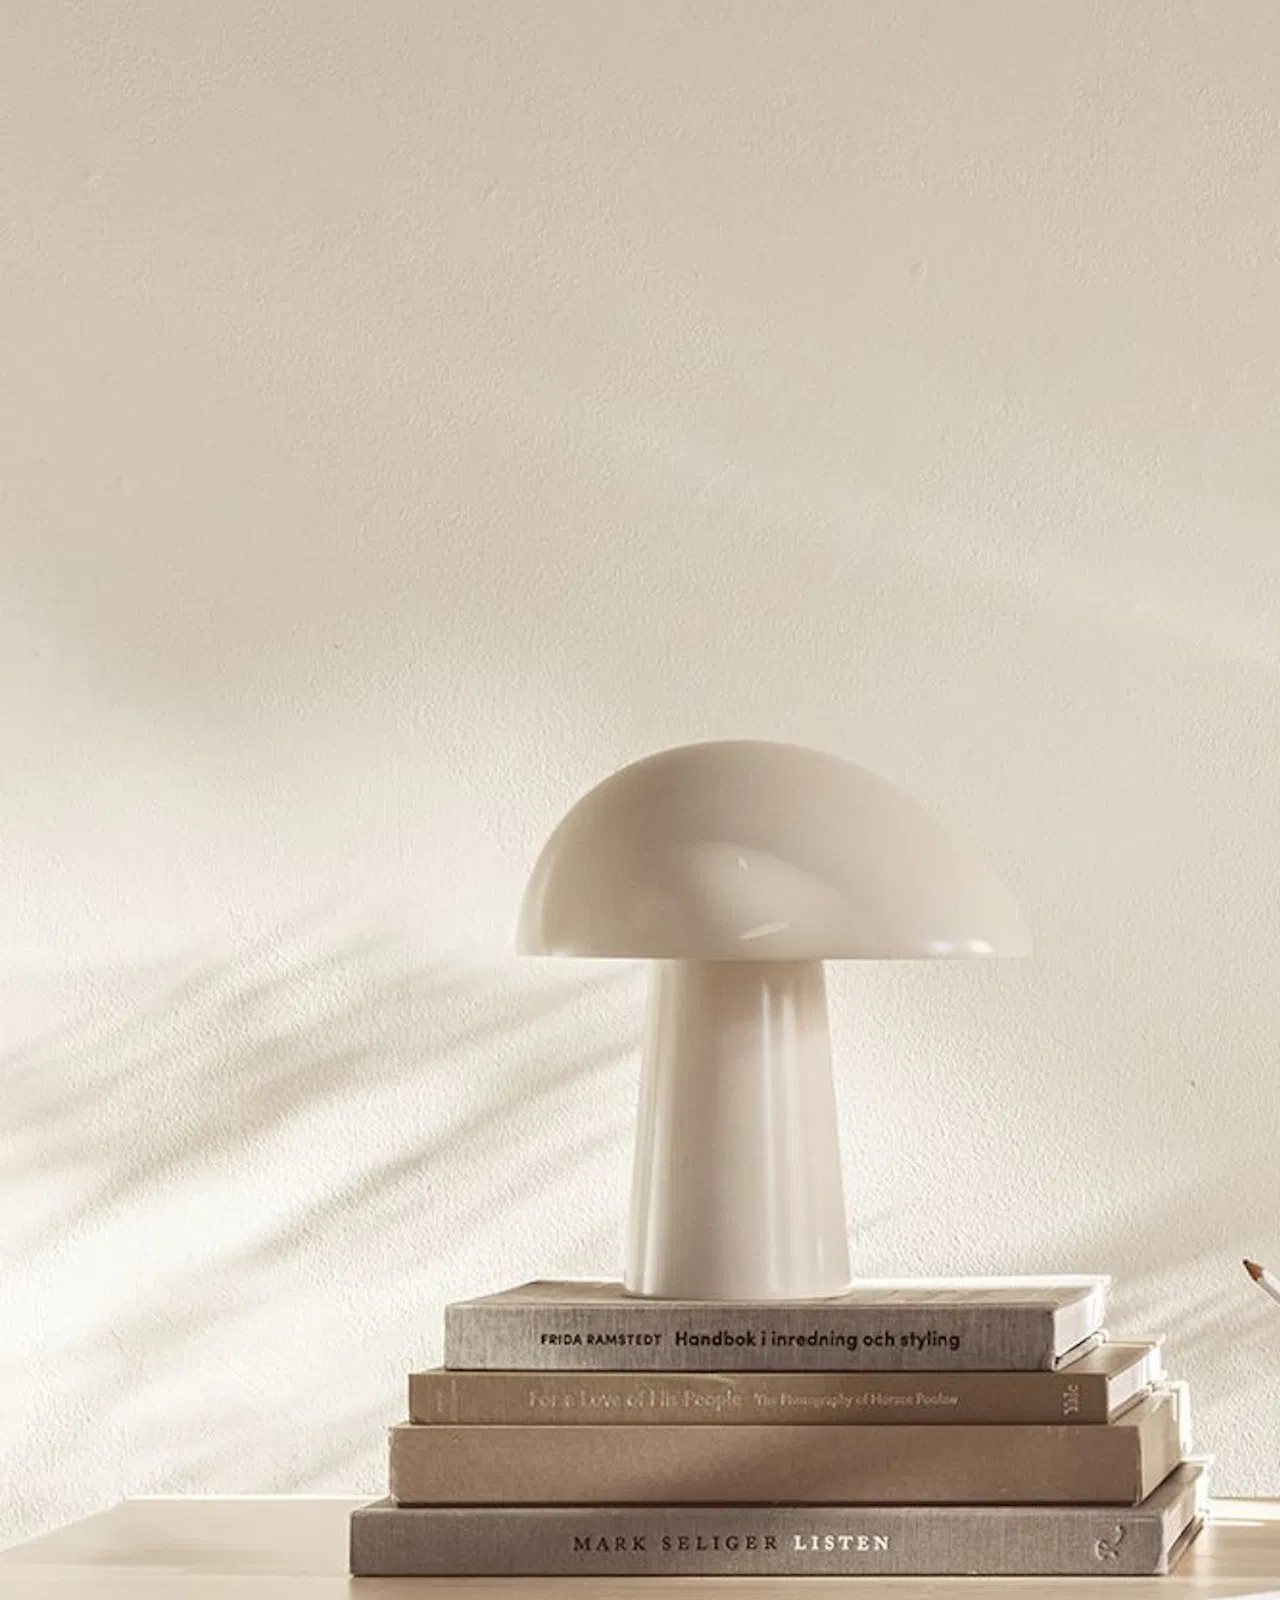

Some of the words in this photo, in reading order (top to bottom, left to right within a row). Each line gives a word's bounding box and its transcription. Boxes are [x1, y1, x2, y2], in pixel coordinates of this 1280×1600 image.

[540, 1333, 583, 1346] FRIDA
[586, 1333, 662, 1346] RAMSTEDT
[674, 1330, 757, 1347] Handbok
[761, 1331, 767, 1347] i
[771, 1331, 858, 1351] inredning
[862, 1331, 896, 1347] och
[900, 1331, 961, 1351] styling
[527, 1388, 558, 1408] For
[683, 1388, 743, 1412] People
[572, 1535, 647, 1551] MARK
[661, 1535, 778, 1551] SELIGER
[793, 1534, 890, 1551] LISTEN
